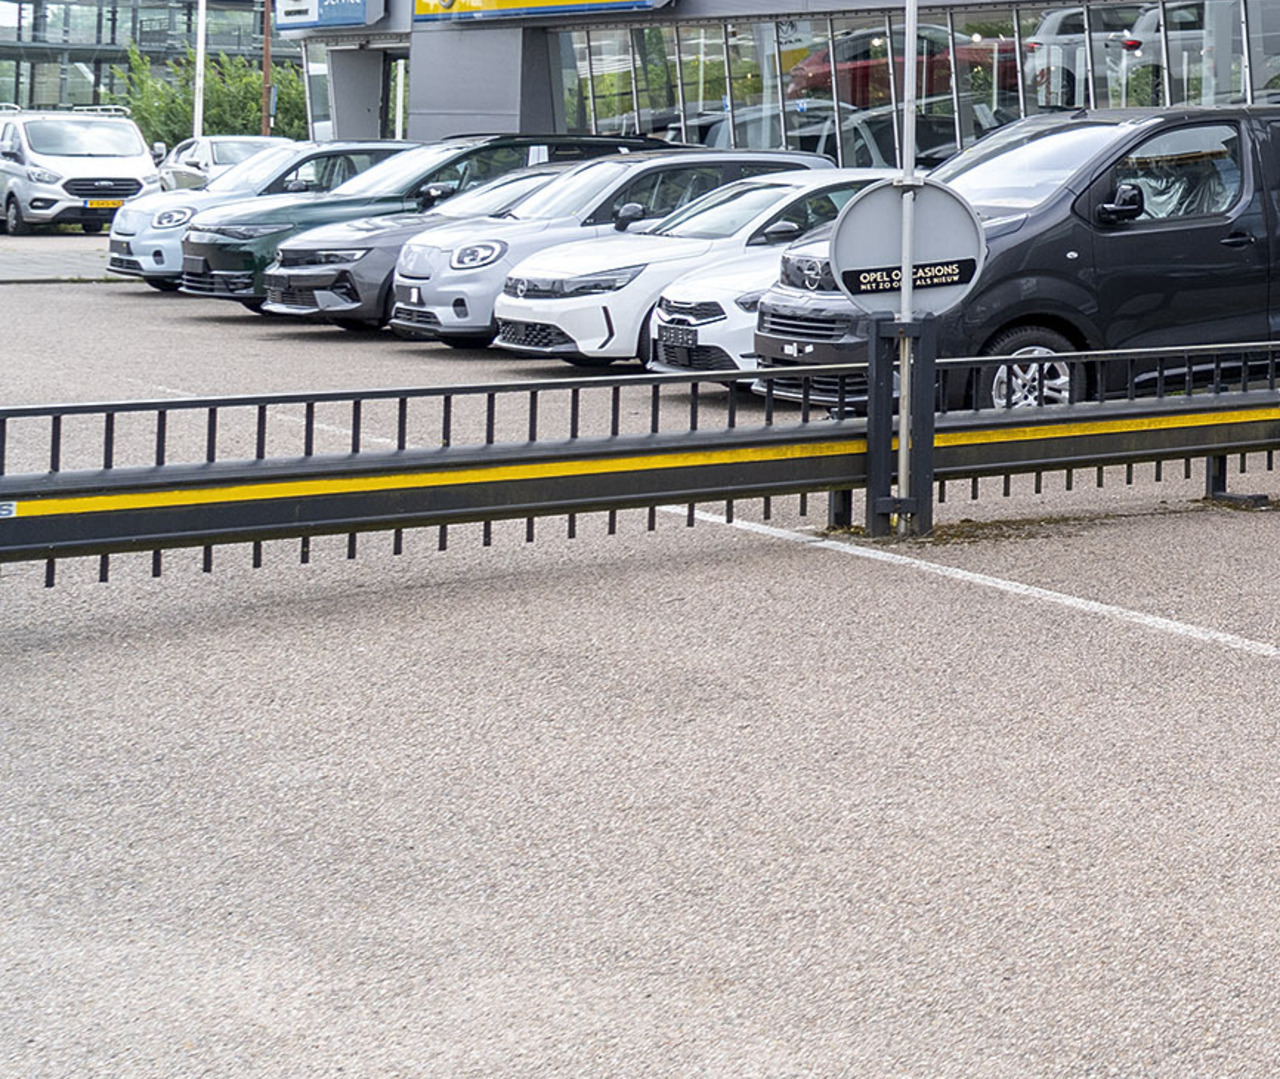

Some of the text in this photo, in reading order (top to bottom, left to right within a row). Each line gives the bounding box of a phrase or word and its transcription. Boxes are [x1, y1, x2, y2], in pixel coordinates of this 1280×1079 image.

[860, 264, 960, 283] OPEL OCASIONS
[915, 278, 932, 286] ALS
[933, 275, 960, 284] NIEUW
